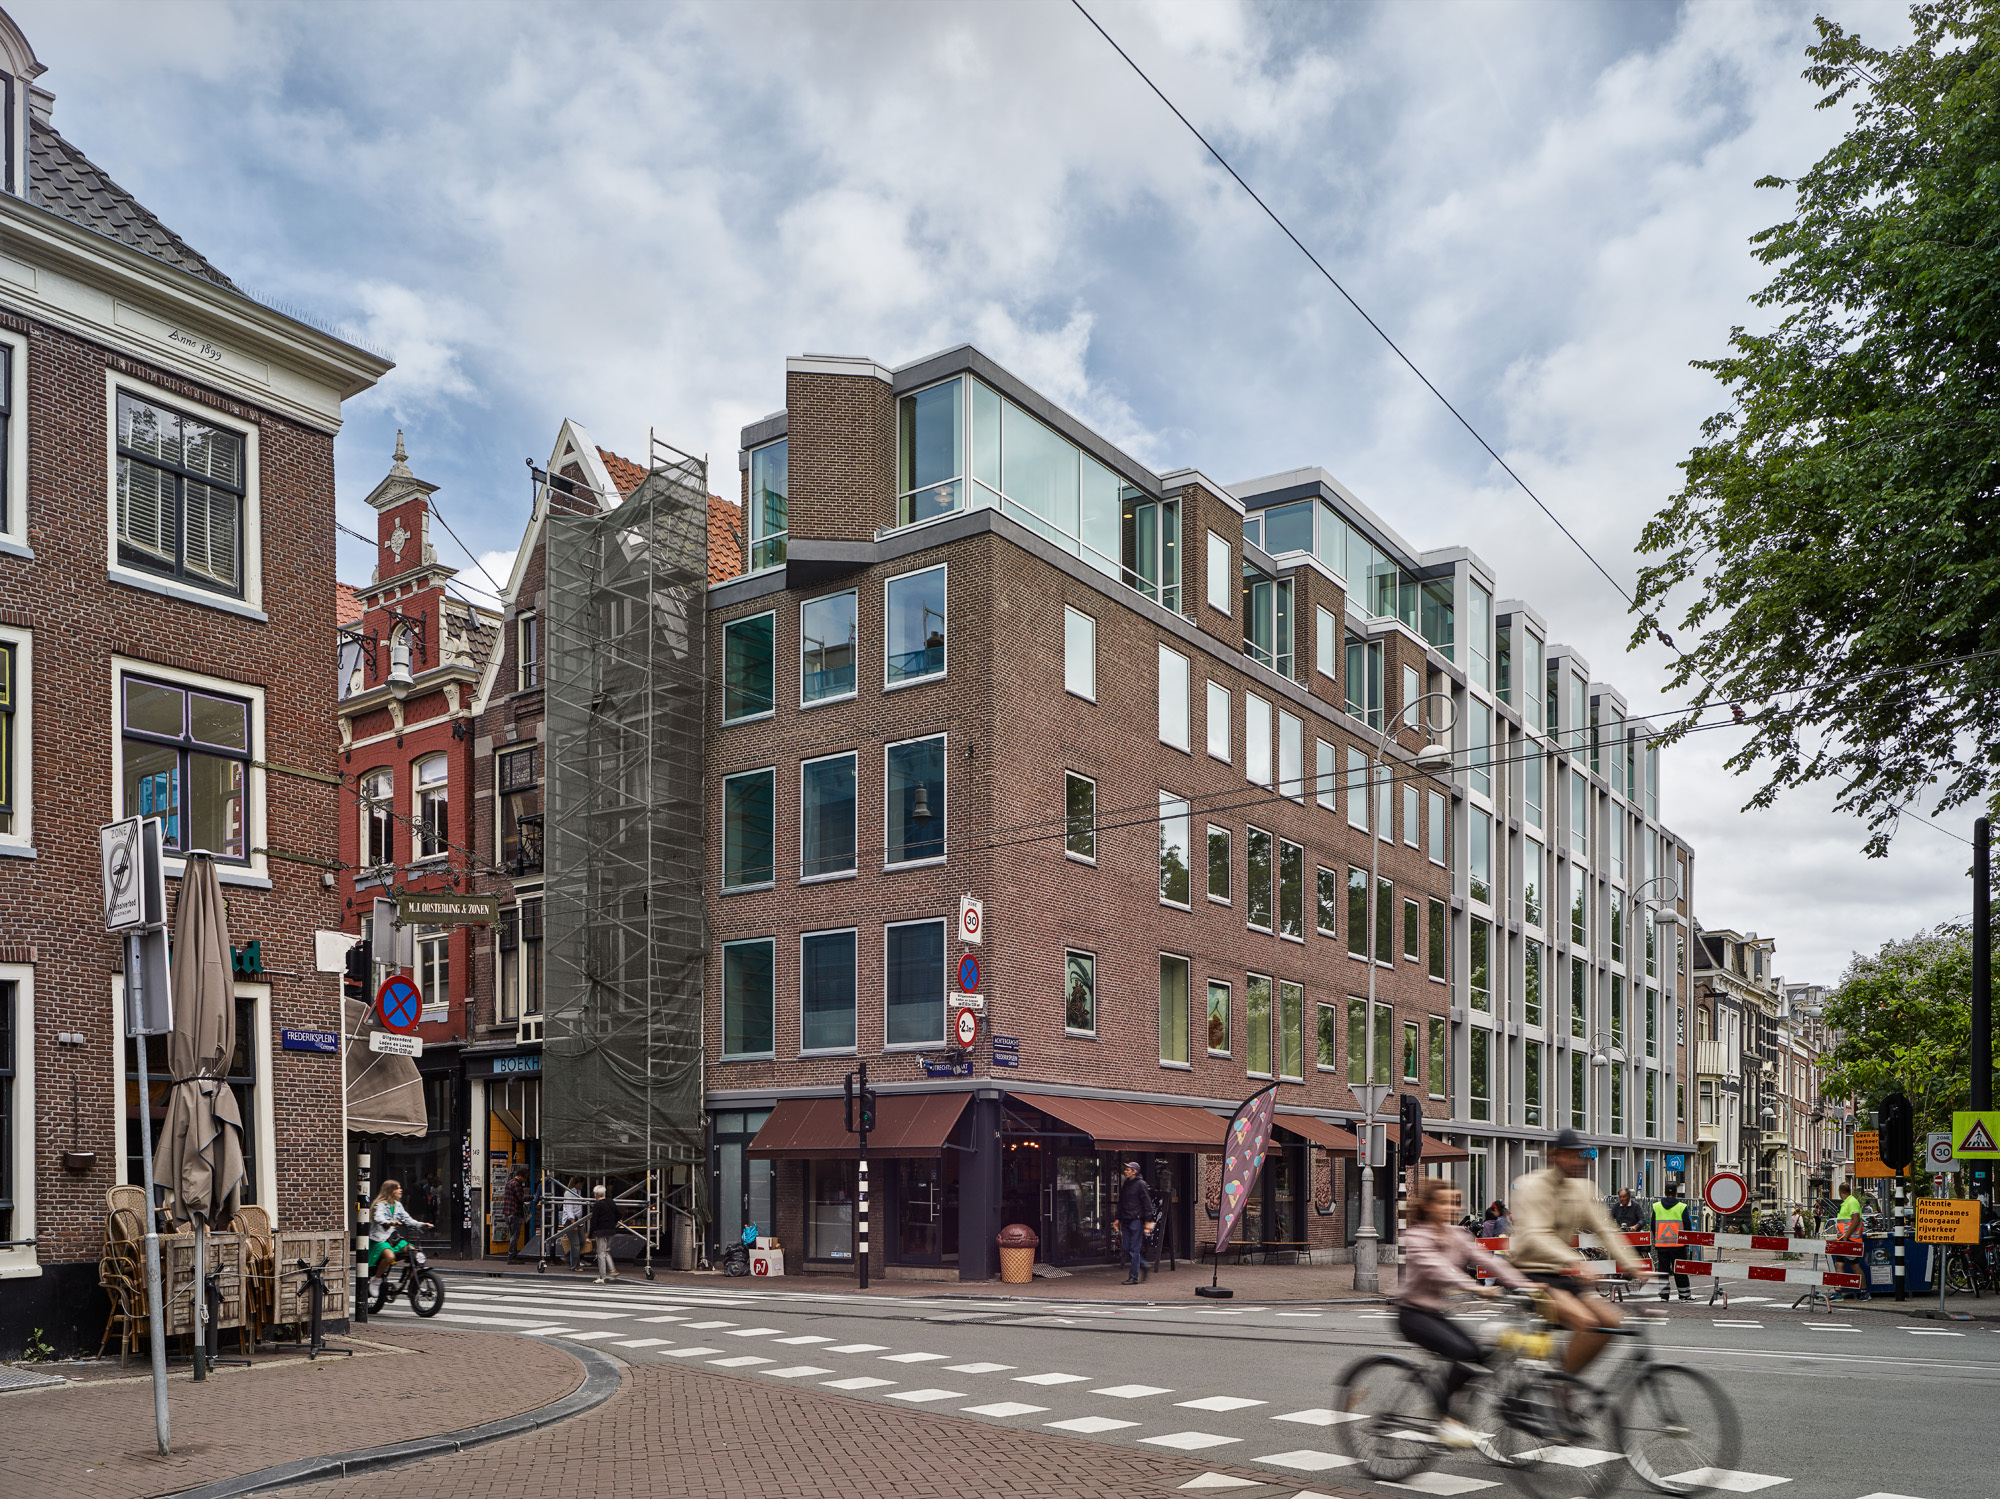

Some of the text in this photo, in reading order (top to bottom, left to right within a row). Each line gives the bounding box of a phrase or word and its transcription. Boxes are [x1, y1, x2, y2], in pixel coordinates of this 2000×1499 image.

[200, 343, 222, 361] 1899
[111, 826, 128, 839] ZONE
[421, 902, 460, 914] OOSTERLING
[461, 904, 467, 914] &
[467, 904, 490, 915] ZONEN
[966, 915, 977, 926] 30
[287, 1031, 335, 1044] FREDERIKSPLEIN
[500, 1056, 542, 1072] BOEKH
[1936, 1148, 1950, 1157] 30
[1919, 1208, 1970, 1217] filmopnames
[1919, 1217, 1960, 1225] doorgaand
[1918, 1225, 1957, 1233] rijverkeer
[1918, 1234, 1955, 1242] gestremd
